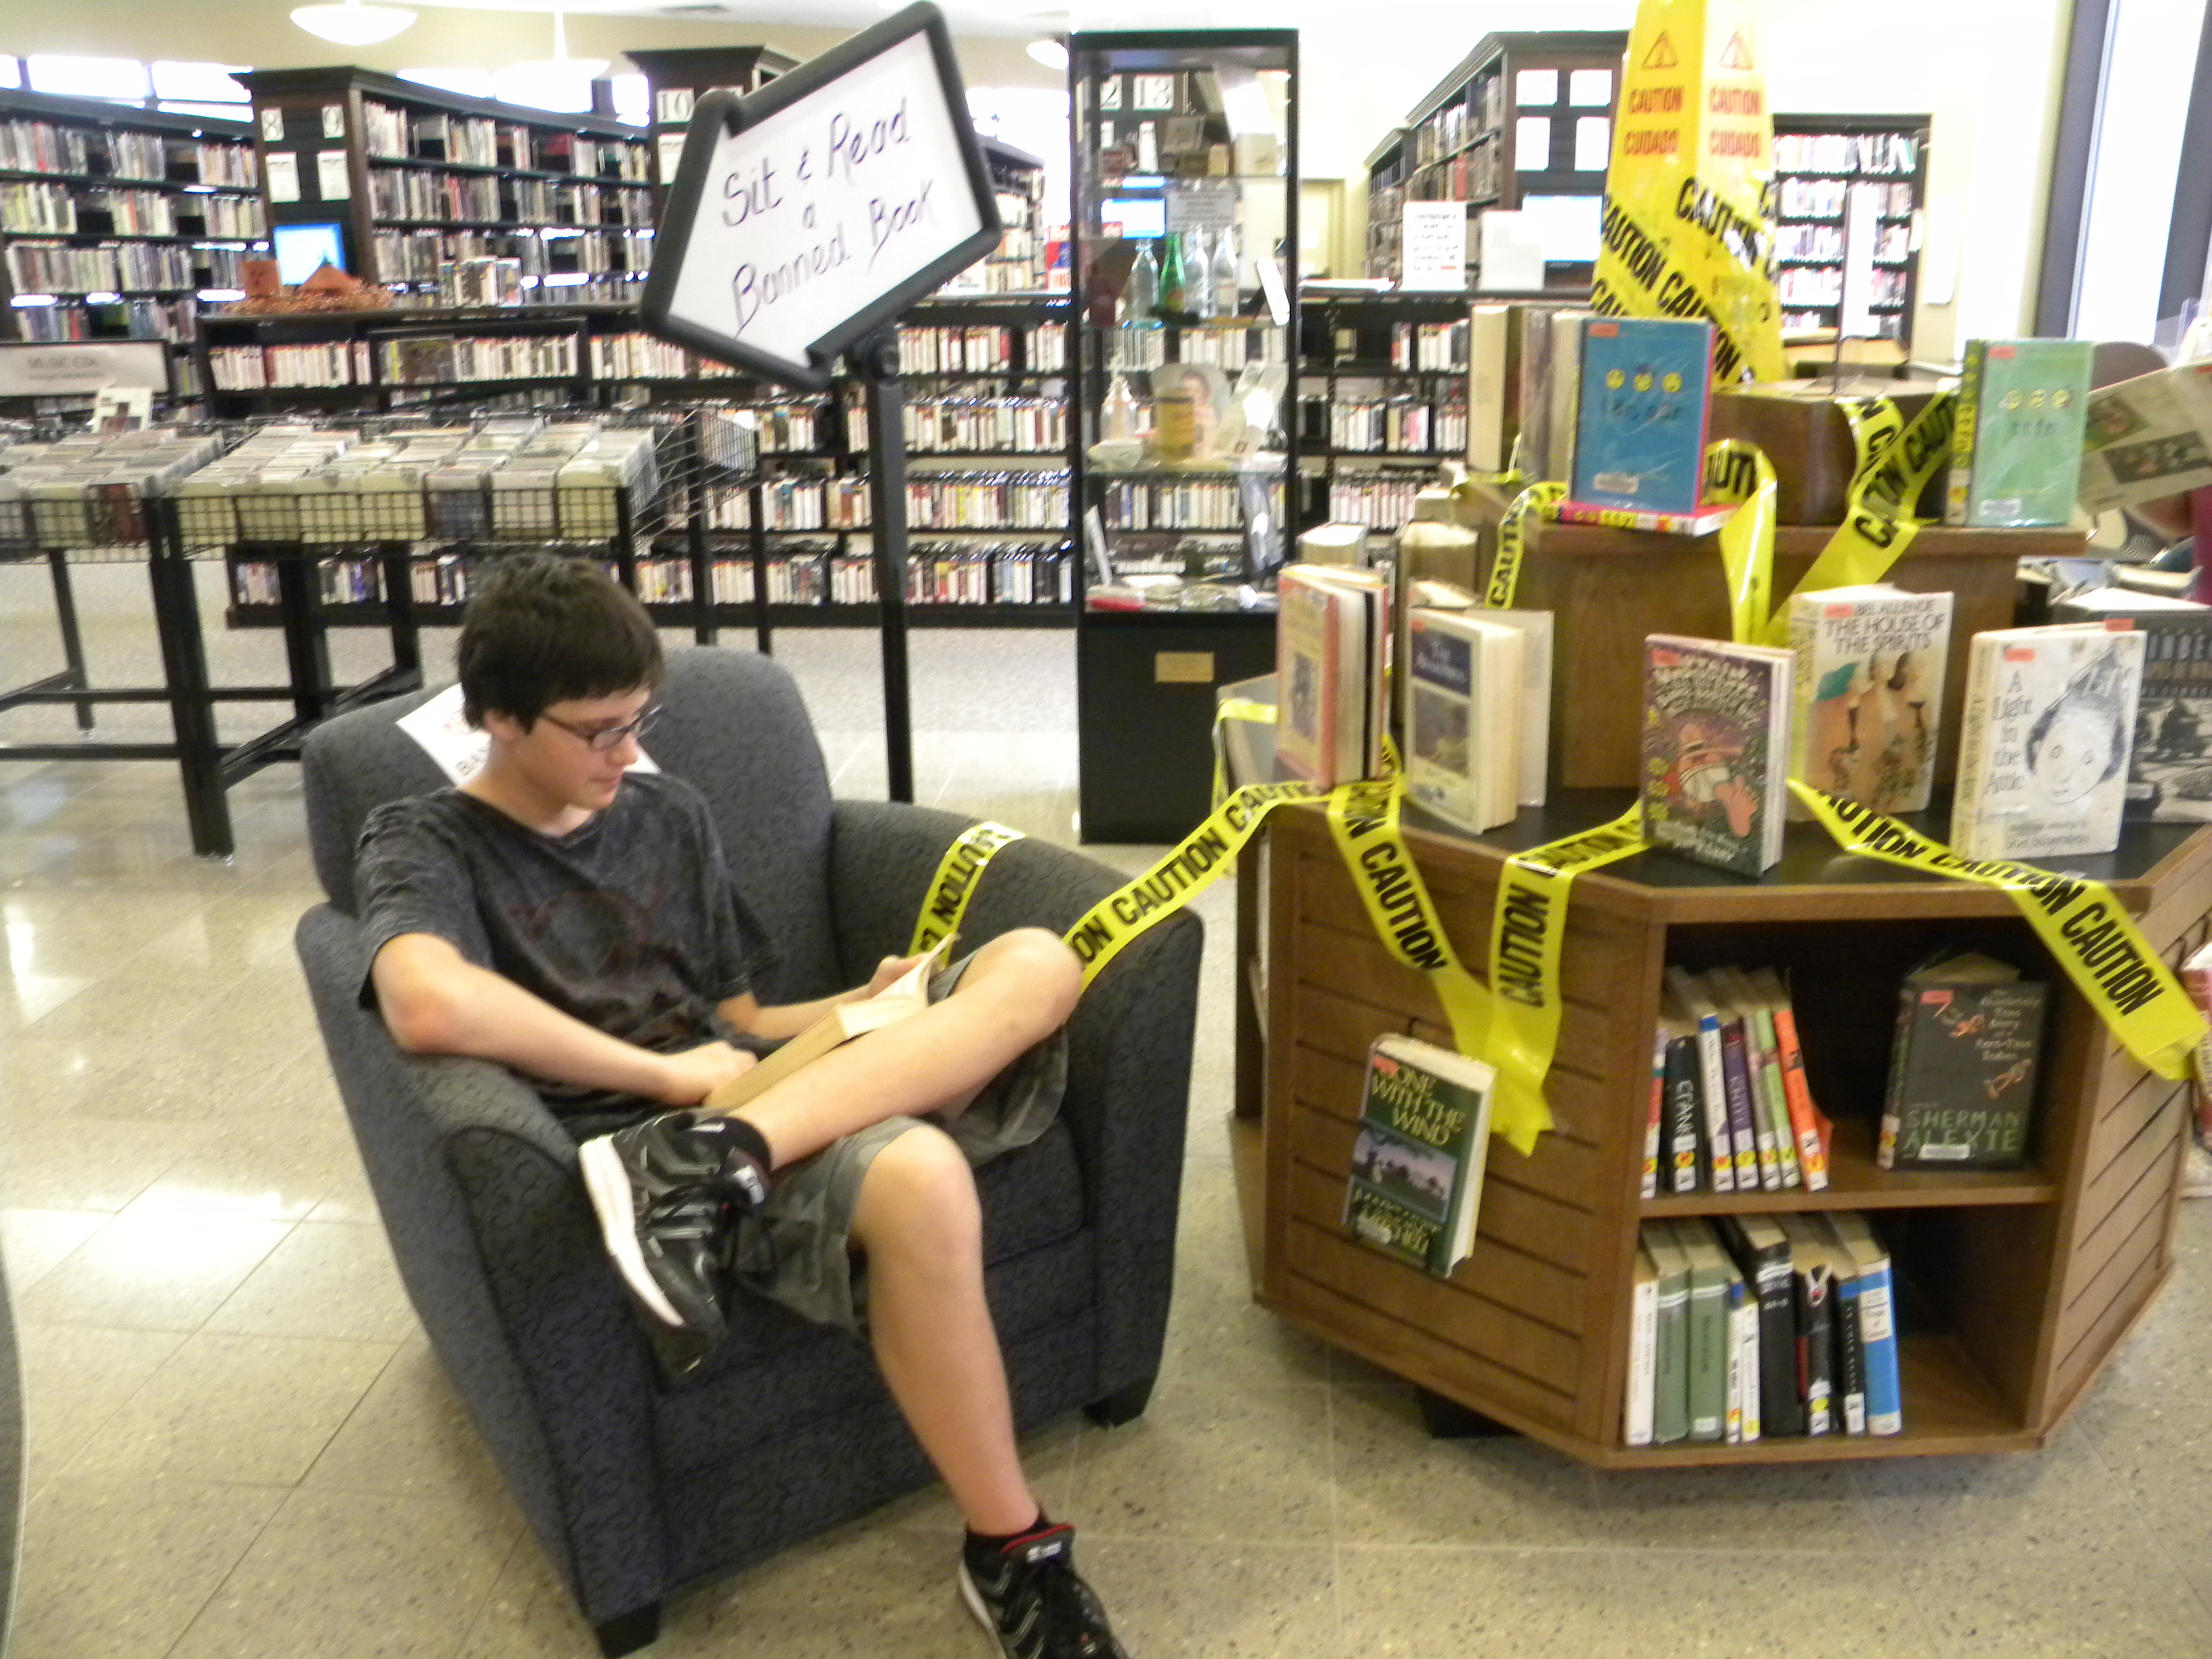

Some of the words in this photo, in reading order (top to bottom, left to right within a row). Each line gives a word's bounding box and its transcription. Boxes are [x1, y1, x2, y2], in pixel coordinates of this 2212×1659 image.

[1628, 85, 1684, 116] CAUTION
[1709, 87, 1762, 117] CAUTION
[1709, 130, 1762, 158] CUIDADO
[722, 158, 783, 227] Sit
[828, 96, 911, 186] Read
[802, 199, 816, 230] a
[731, 220, 851, 340] Banned
[868, 178, 939, 274] Book
[1601, 193, 1669, 293] AUTION
[1825, 618, 1860, 638] THE
[1863, 614, 1919, 635] HOUSE
[1920, 612, 1946, 631] OF
[1833, 635, 1869, 655] THE
[2006, 669, 2022, 694] A
[1993, 746, 2022, 767] the
[1111, 828, 1229, 927] CAUTION
[1361, 841, 1450, 971] CAUTION
[1824, 793, 1930, 860] UTION
[2061, 901, 2166, 1020] CAUTION
[1499, 883, 1553, 1008] CAUTION
[1396, 1065, 1438, 1098] ONE
[1371, 1075, 1423, 1115] WITH
[1426, 1100, 1466, 1133] THE
[1905, 1109, 2021, 1130] SHERMAN
[1393, 1108, 1451, 1146] WIND
[1903, 1128, 2020, 1154] ALEXIE
